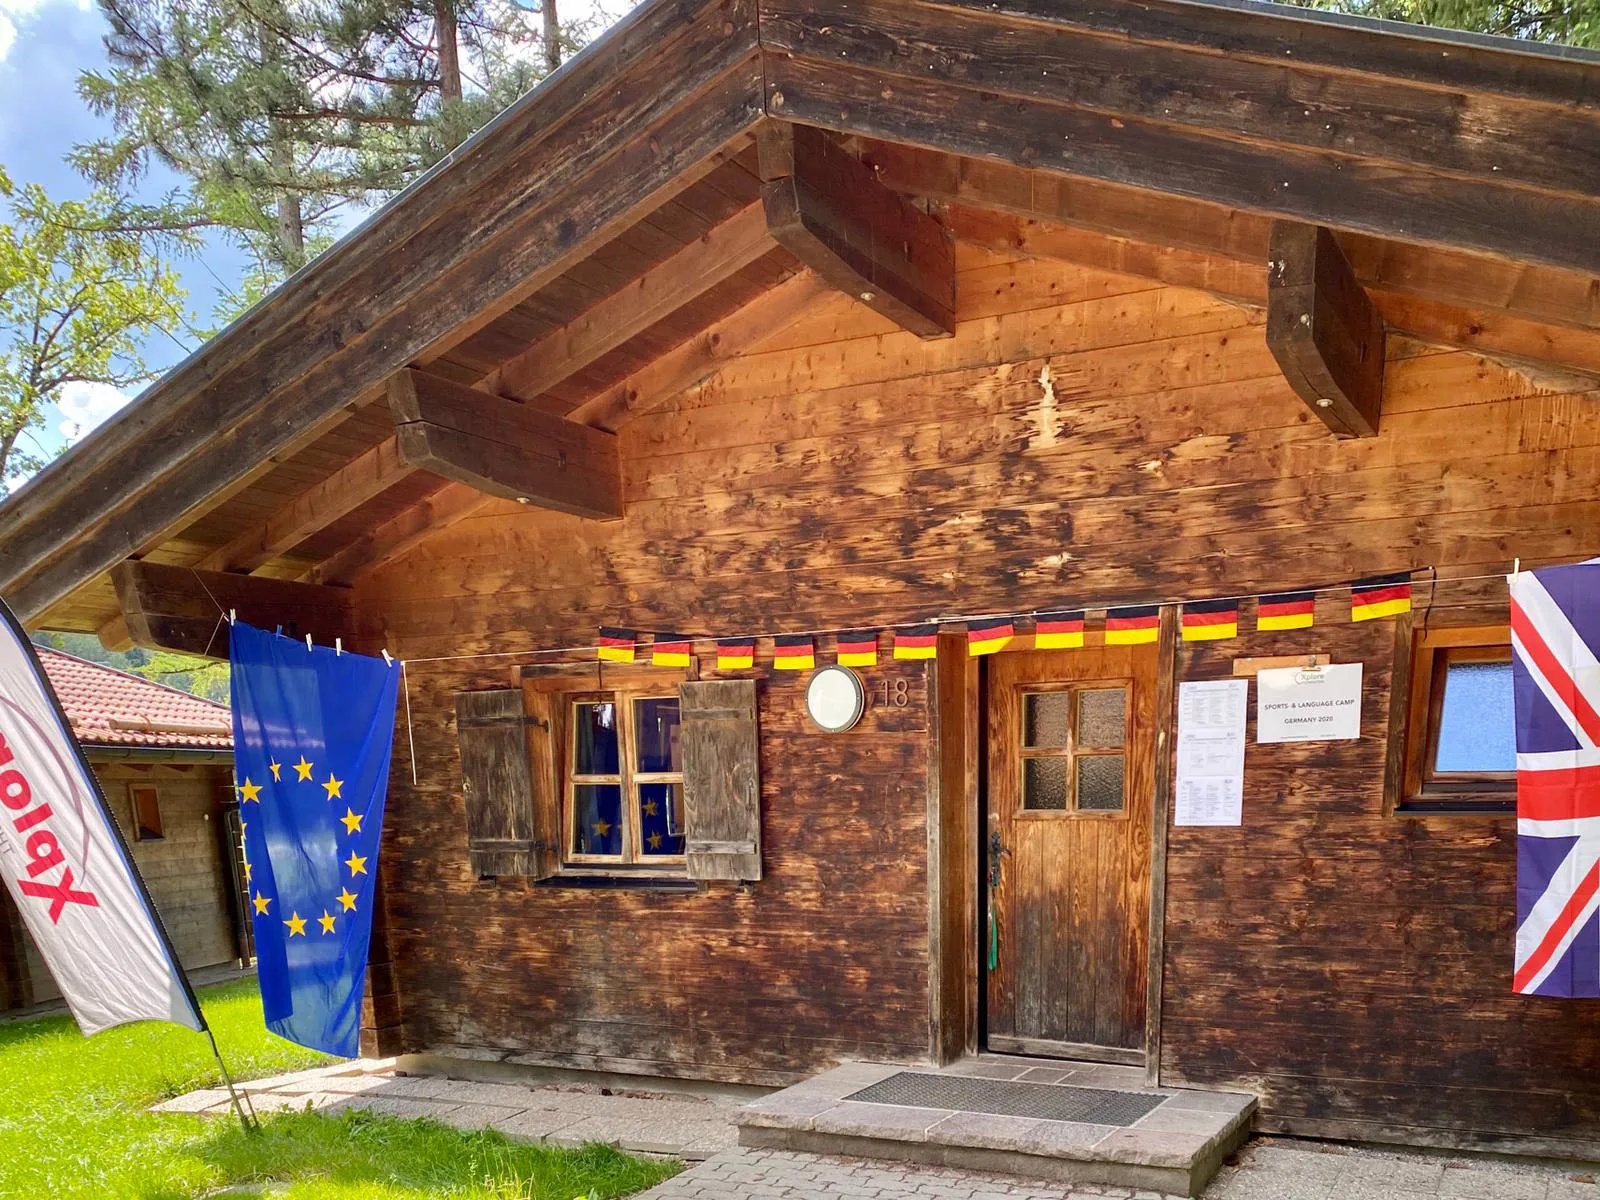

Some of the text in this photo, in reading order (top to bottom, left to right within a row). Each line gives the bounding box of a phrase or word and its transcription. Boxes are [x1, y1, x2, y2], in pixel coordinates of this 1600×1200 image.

[881, 679, 908, 707] 18
[1298, 700, 1334, 709] LANGUAGE
[1284, 716, 1317, 724] GERMANY
